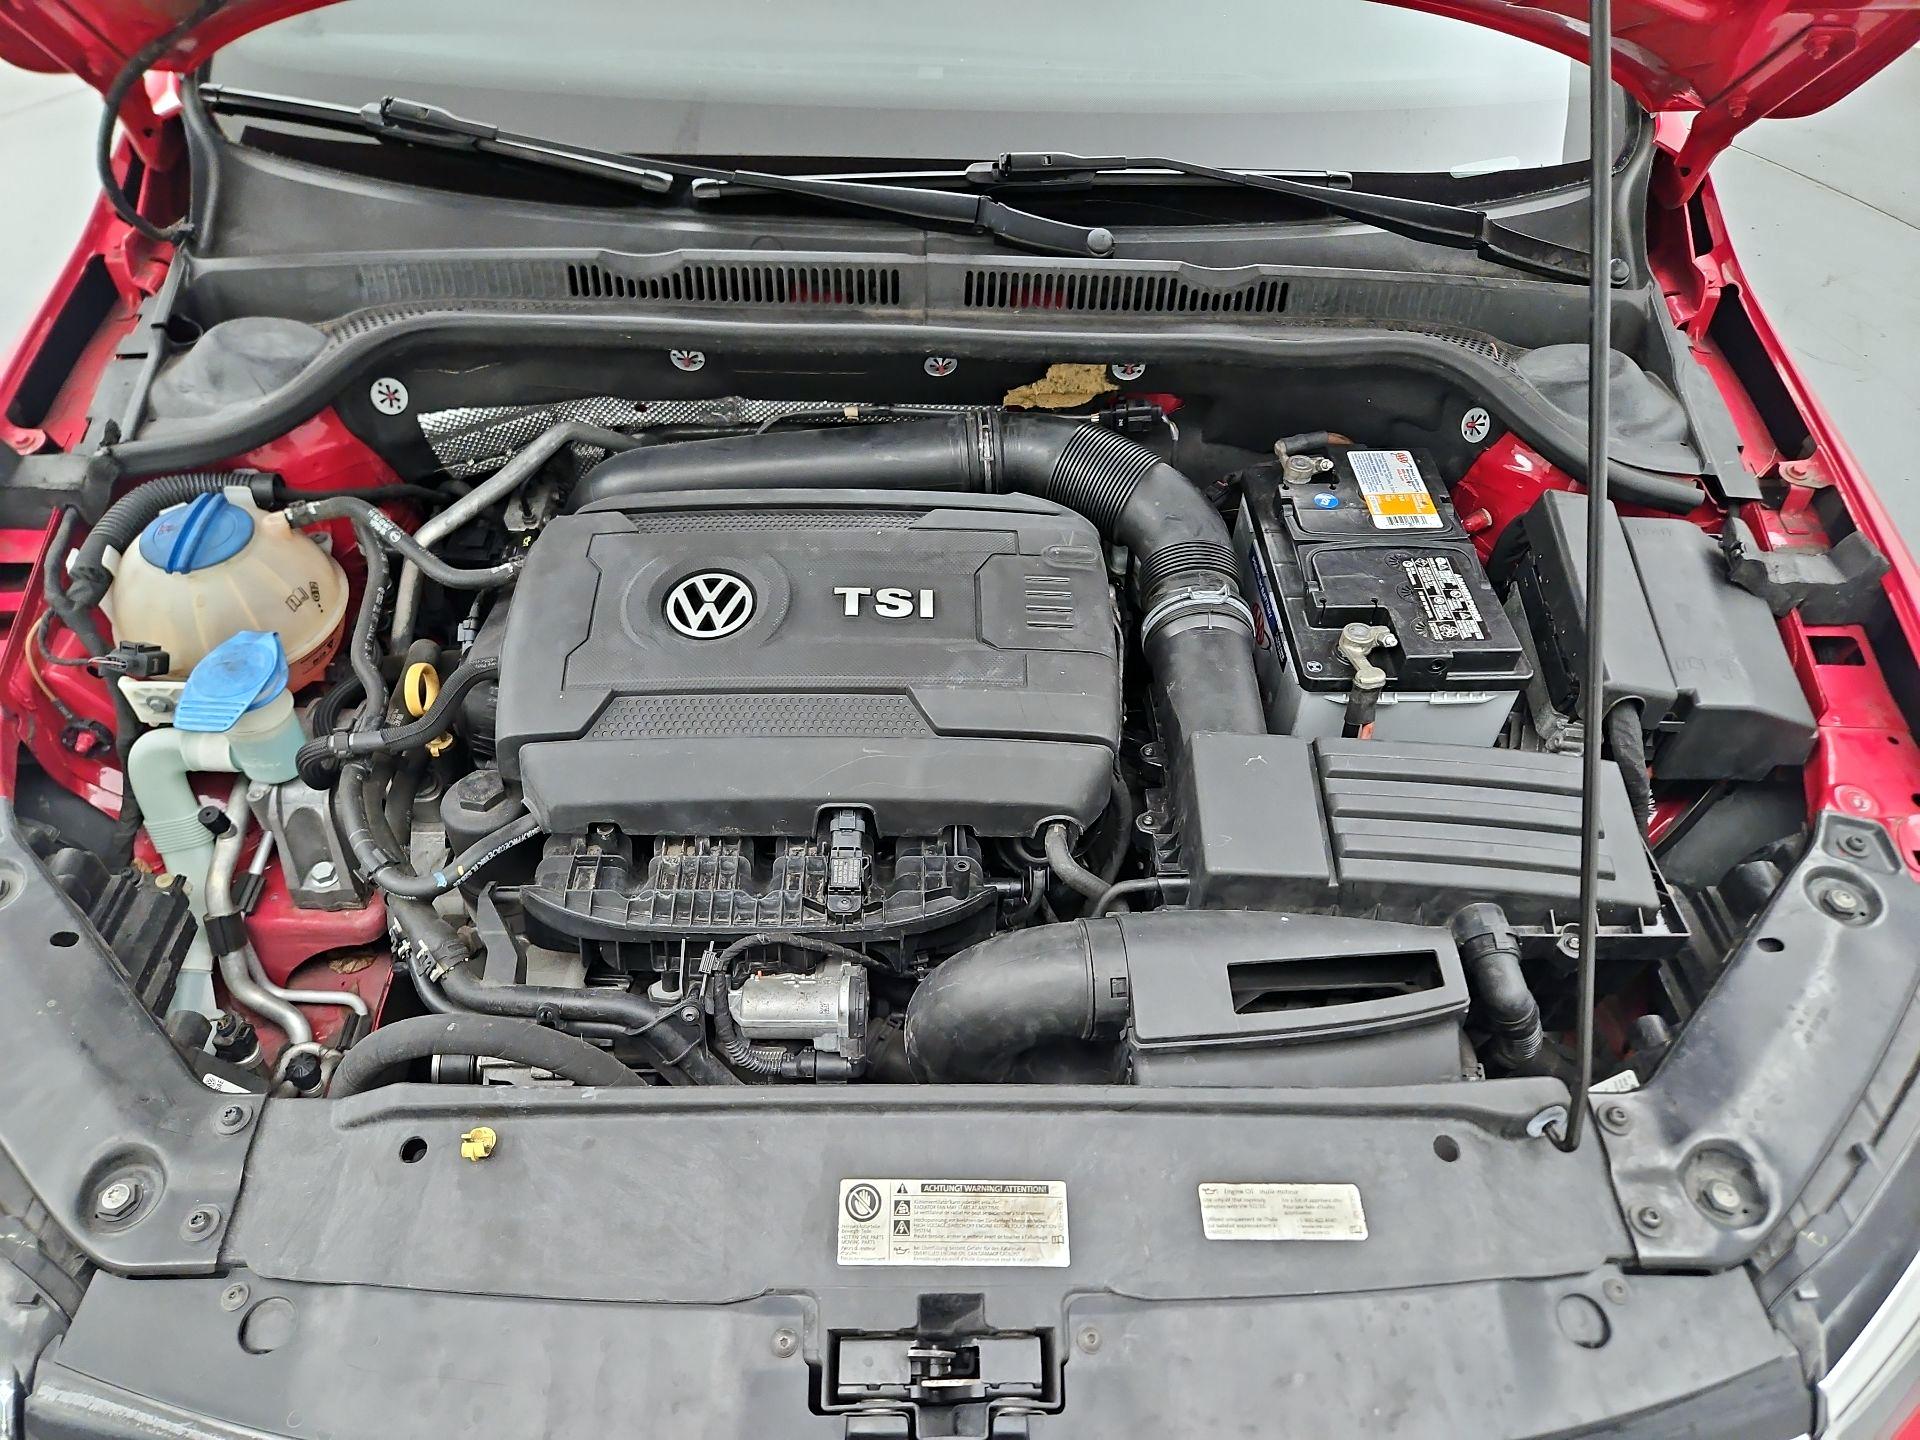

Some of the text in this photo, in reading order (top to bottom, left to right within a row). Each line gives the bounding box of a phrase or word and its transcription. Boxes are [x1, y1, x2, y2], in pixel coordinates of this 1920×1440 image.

[833, 586, 935, 619] TSI
[923, 1184, 1047, 1193] ACHTUNG! WARNING! ATTENTION!
